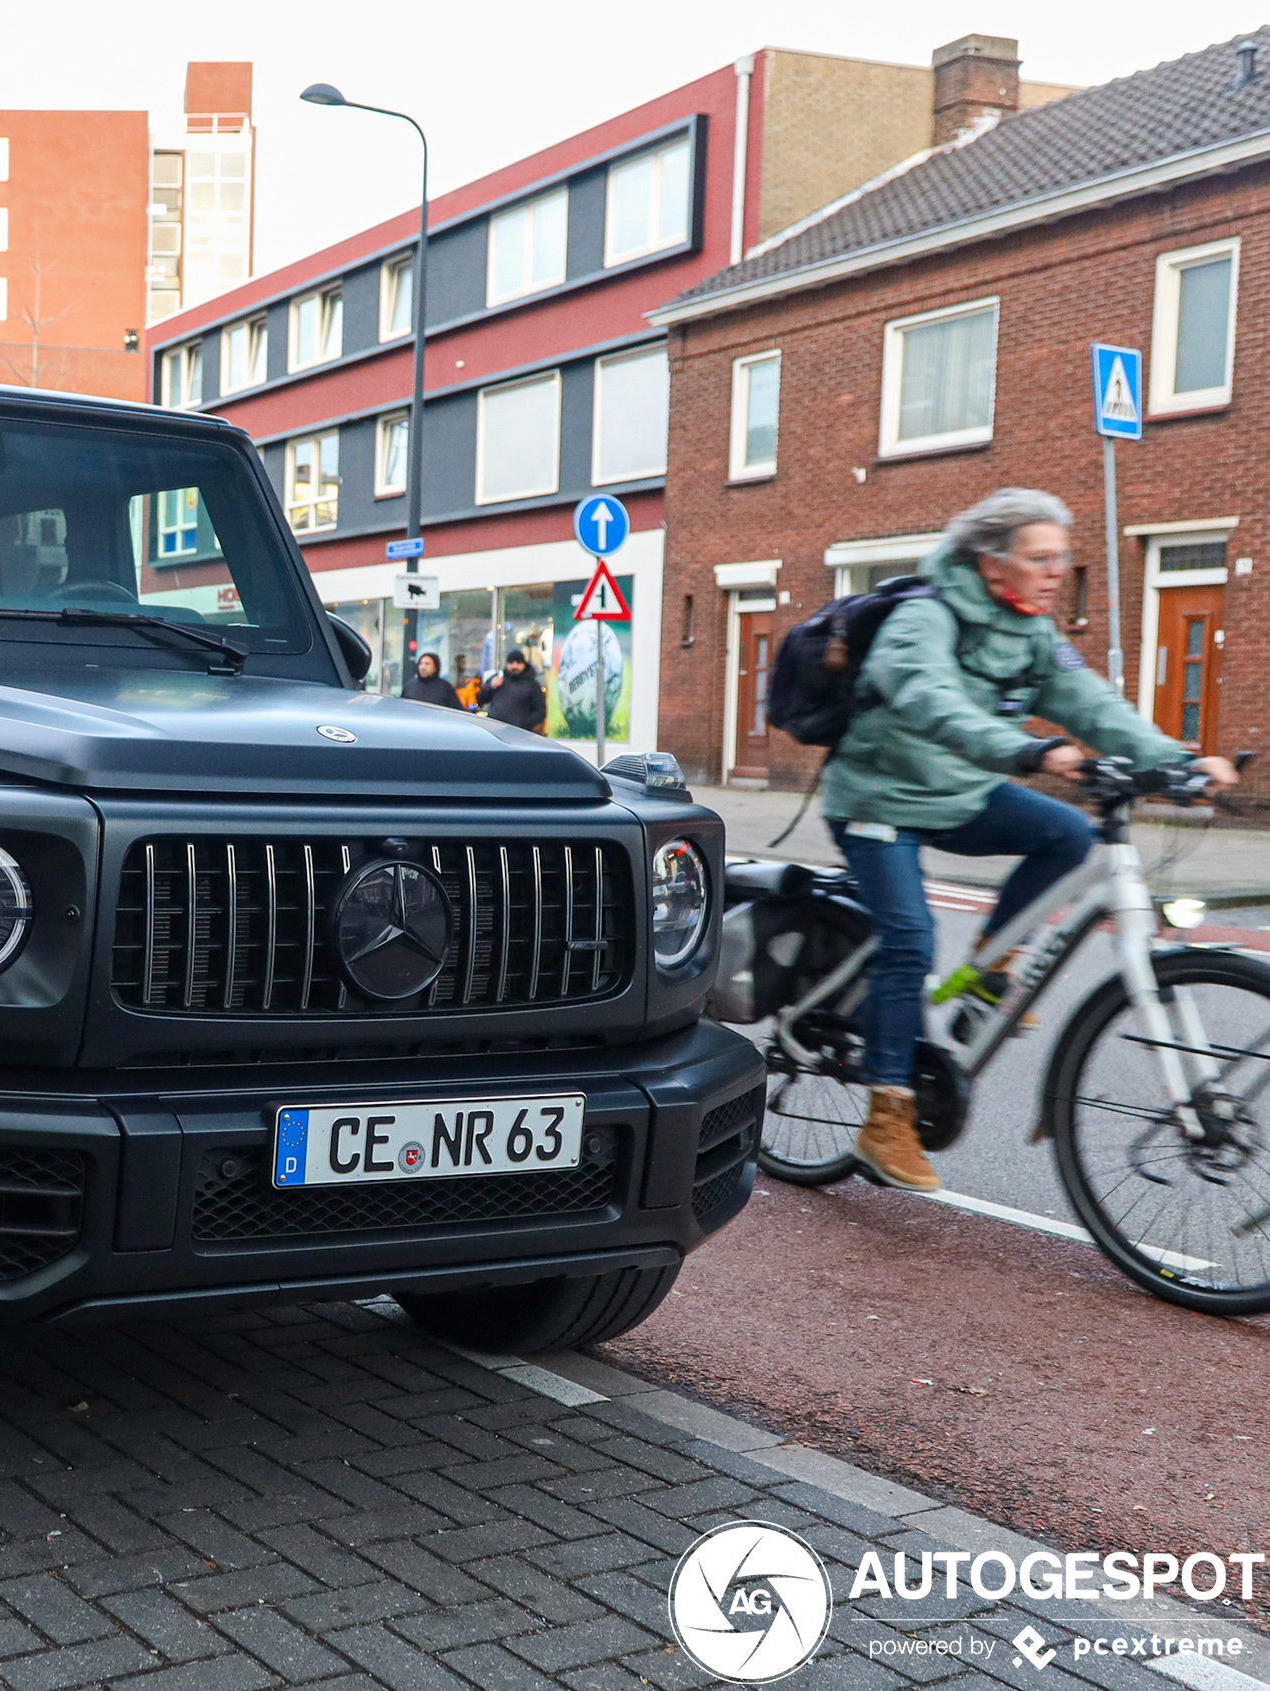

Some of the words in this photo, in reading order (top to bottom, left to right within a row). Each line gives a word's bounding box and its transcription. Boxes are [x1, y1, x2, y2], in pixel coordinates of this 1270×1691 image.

[329, 1115, 396, 1174] CE
[431, 1110, 495, 1168] NR
[507, 1106, 565, 1163] 63
[285, 1156, 298, 1174] D
